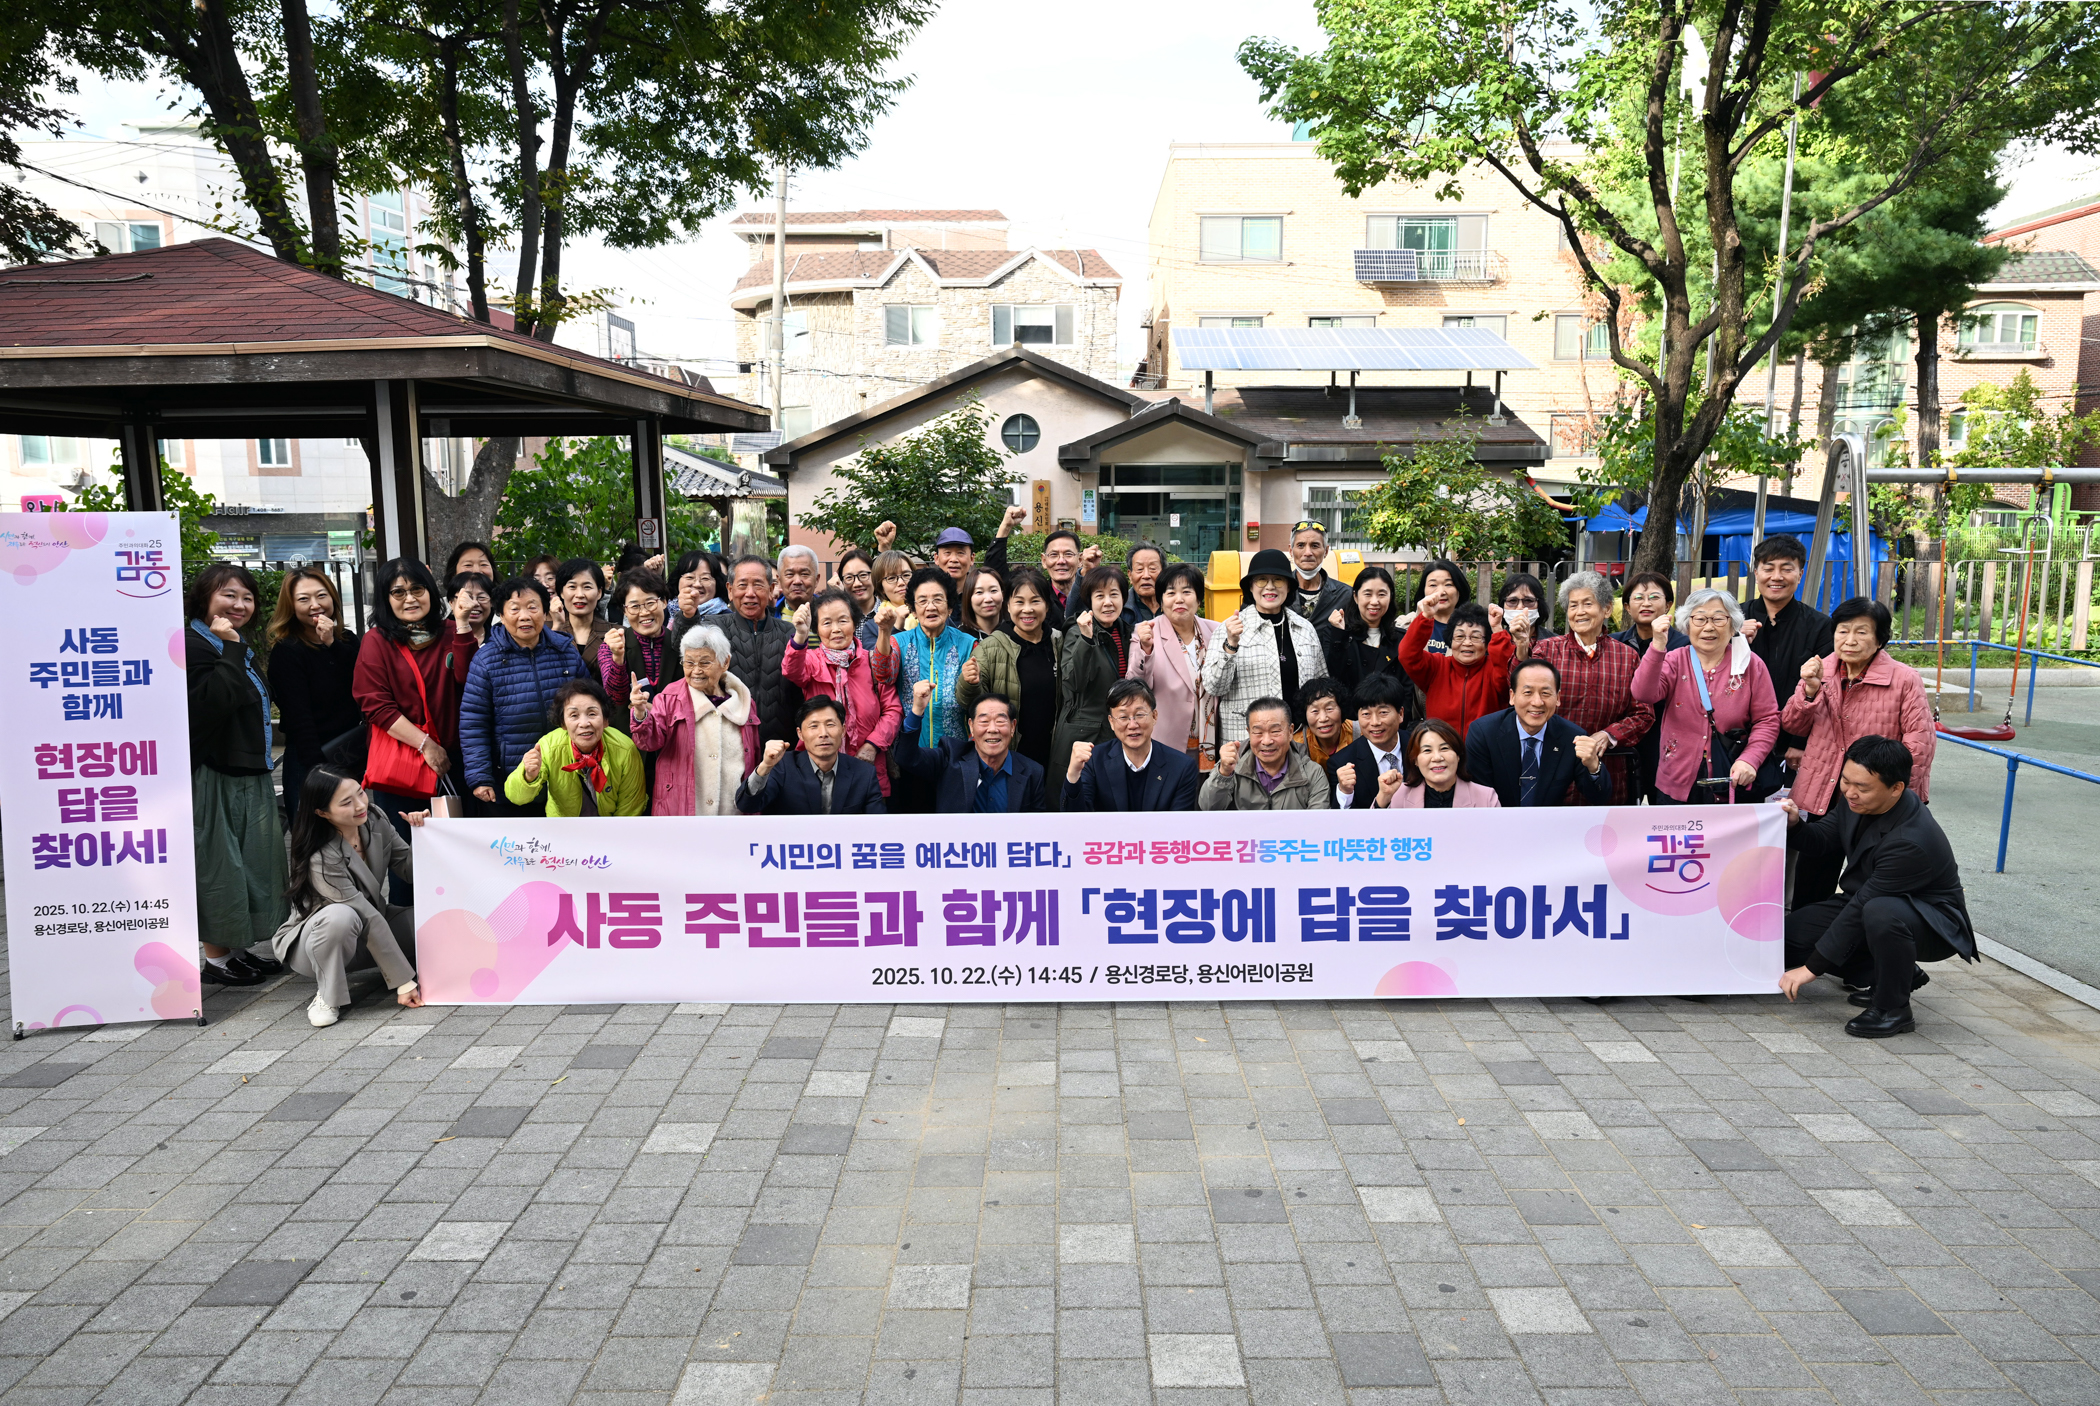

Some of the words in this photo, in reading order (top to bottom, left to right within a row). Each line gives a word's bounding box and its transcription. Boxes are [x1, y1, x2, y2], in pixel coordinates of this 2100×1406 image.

[212, 502, 250, 516] Hair
[149, 539, 163, 549] 25
[60, 627, 119, 655] 사동
[29, 659, 154, 689] 주민들과
[62, 692, 123, 722] 함께
[33, 740, 158, 780] 현장에
[57, 785, 139, 824] 답을
[1651, 824, 1687, 832] 주민과의대화
[1687, 820, 1704, 831] 25
[32, 828, 168, 871] 찾아서!
[581, 854, 613, 870] 안산
[749, 843, 842, 871] 「시민의
[851, 842, 906, 870] 꿈을
[915, 842, 998, 869] 예산에
[1006, 841, 1072, 869] 담다」
[1082, 840, 1147, 866] 공감과
[1148, 839, 1234, 865] 동행으로
[1235, 838, 1321, 864] 감동주는
[1323, 837, 1388, 863] 따뜻한
[1389, 836, 1433, 862] 행정
[1646, 834, 1711, 883] 감동
[33, 905, 69, 917] 2025.
[71, 903, 90, 915] 10.
[134, 898, 170, 911] 14:45
[547, 892, 662, 949] 사동
[684, 890, 924, 949] 주민들과
[942, 888, 1060, 947] 함께
[1081, 887, 1277, 945] 「현장에
[1298, 885, 1412, 943] 답을
[1433, 883, 1630, 942] 찾아서」
[33, 921, 92, 936] 용신경로당,
[93, 916, 170, 933] 용신어린이공원
[871, 967, 925, 986] 2025.
[931, 966, 958, 985] 10.
[962, 965, 1022, 987] 22.(수)
[1028, 965, 1083, 985] 14:45
[1089, 965, 1099, 985] /
[1104, 963, 1194, 986] 용신경로당,
[1196, 961, 1314, 984] 용신어린이공원
